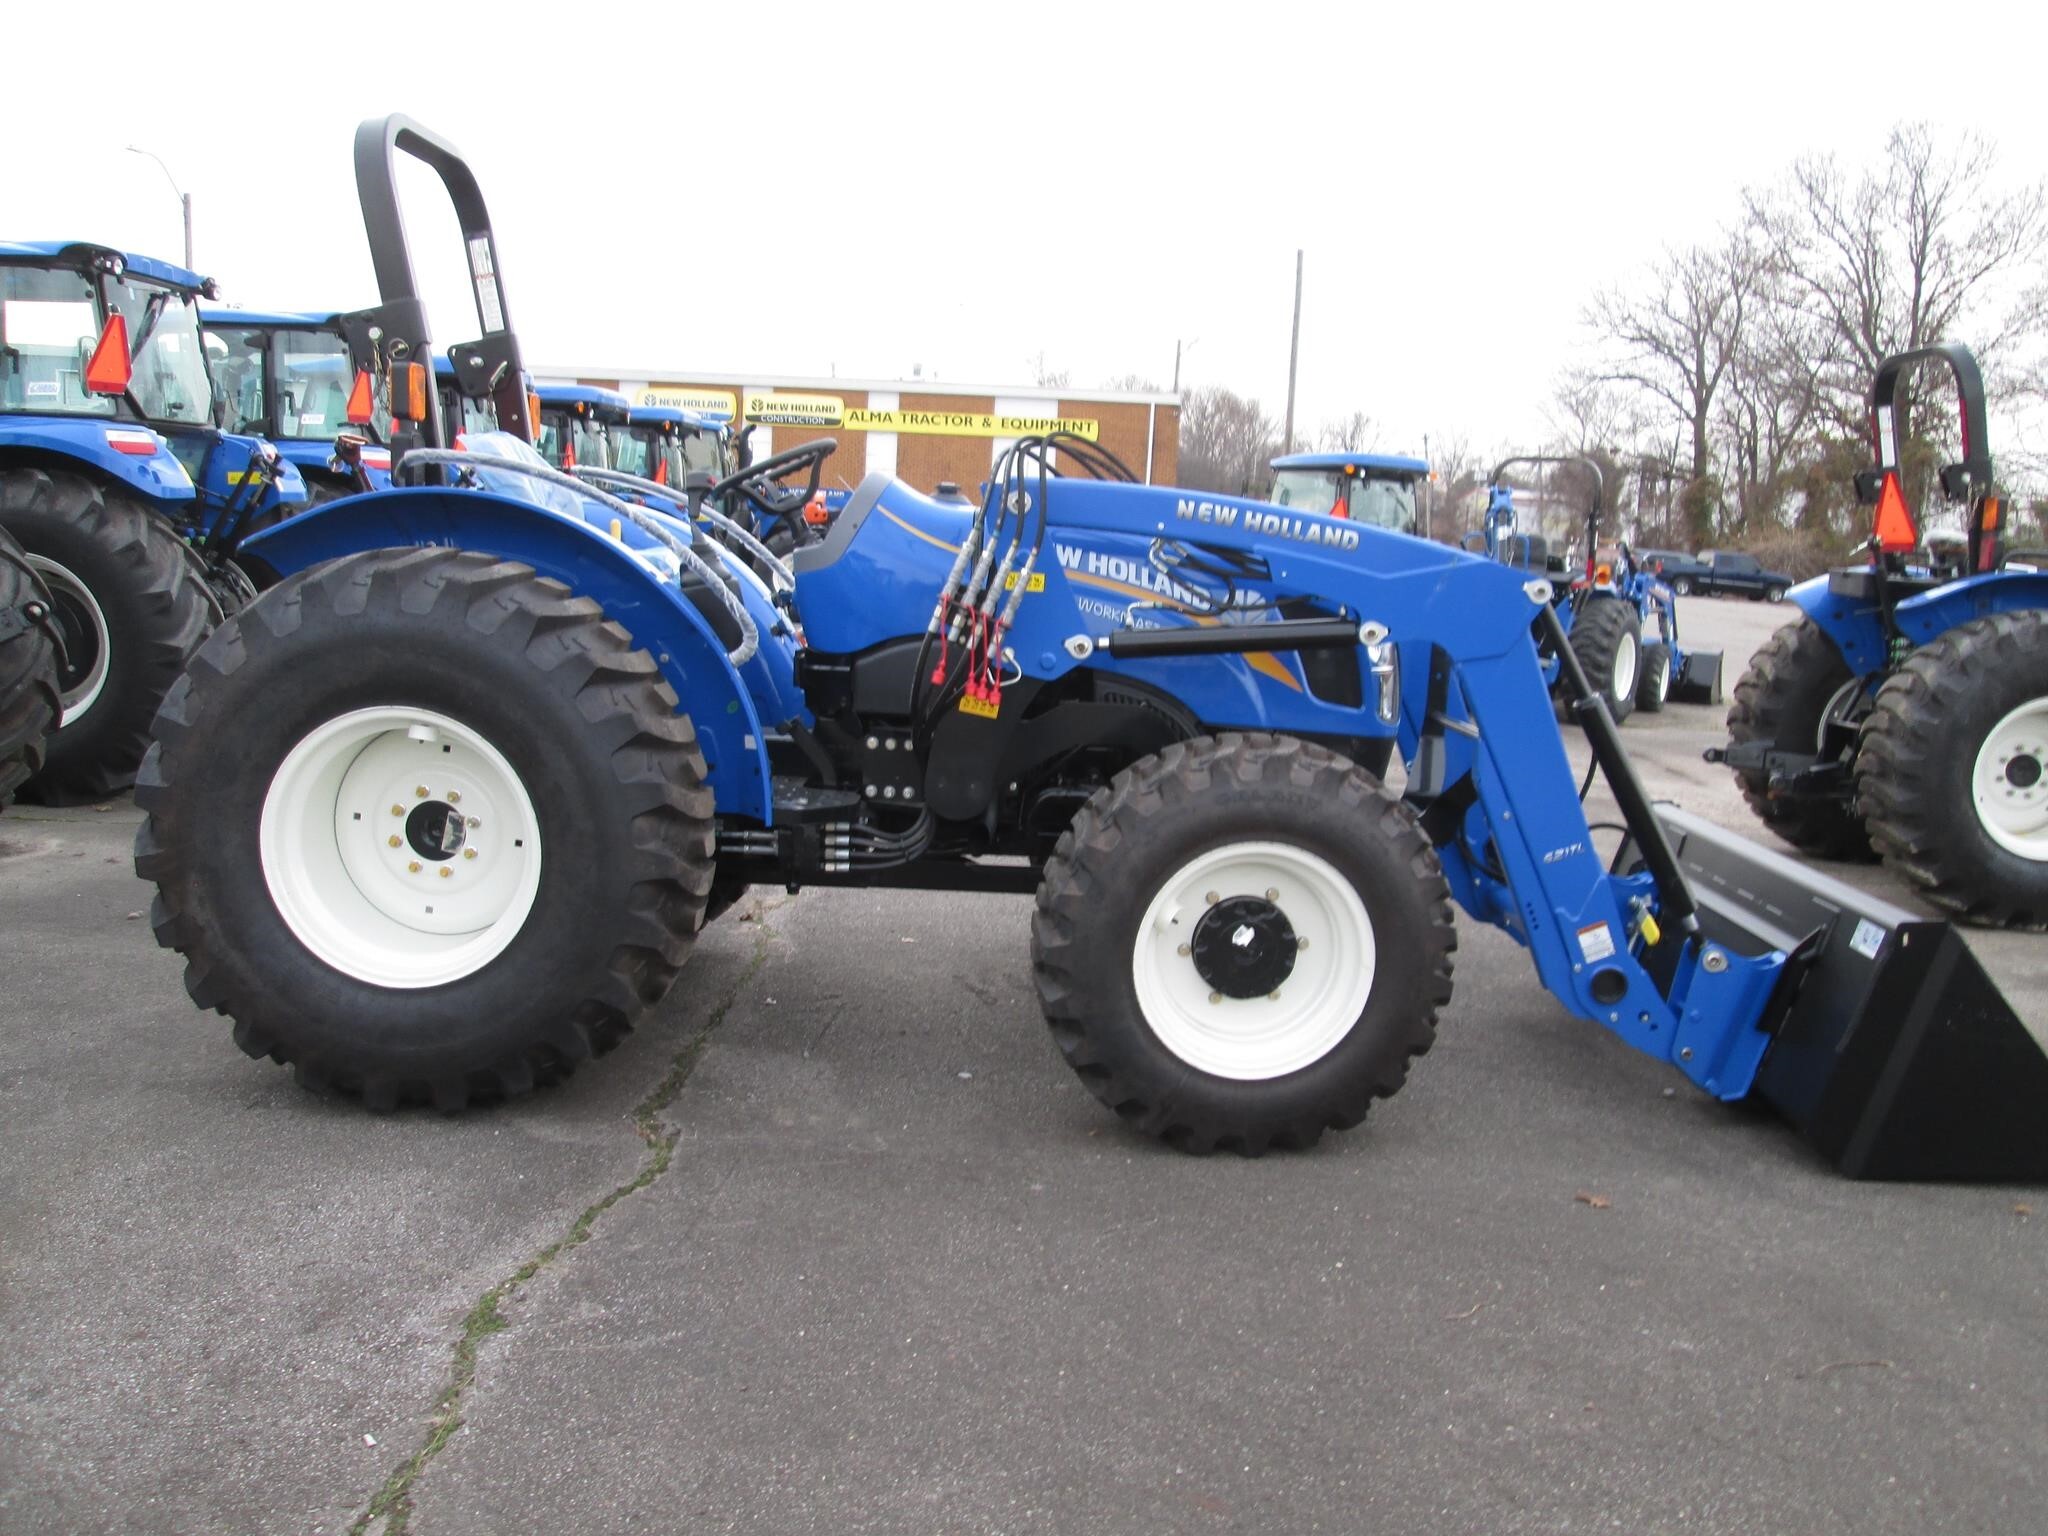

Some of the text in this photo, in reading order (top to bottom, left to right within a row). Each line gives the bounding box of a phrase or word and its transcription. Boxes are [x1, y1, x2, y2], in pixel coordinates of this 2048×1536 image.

[659, 398, 728, 409] NEW HOLLAND
[766, 402, 836, 413] NEW HOLLAND
[760, 415, 826, 425] CONSTRUCTION
[849, 411, 1093, 433] ALMA TRACTOR & EQUIPMENT
[1176, 499, 1360, 550] NEW HOLLAND
[1088, 551, 1212, 610] HOLLAND
